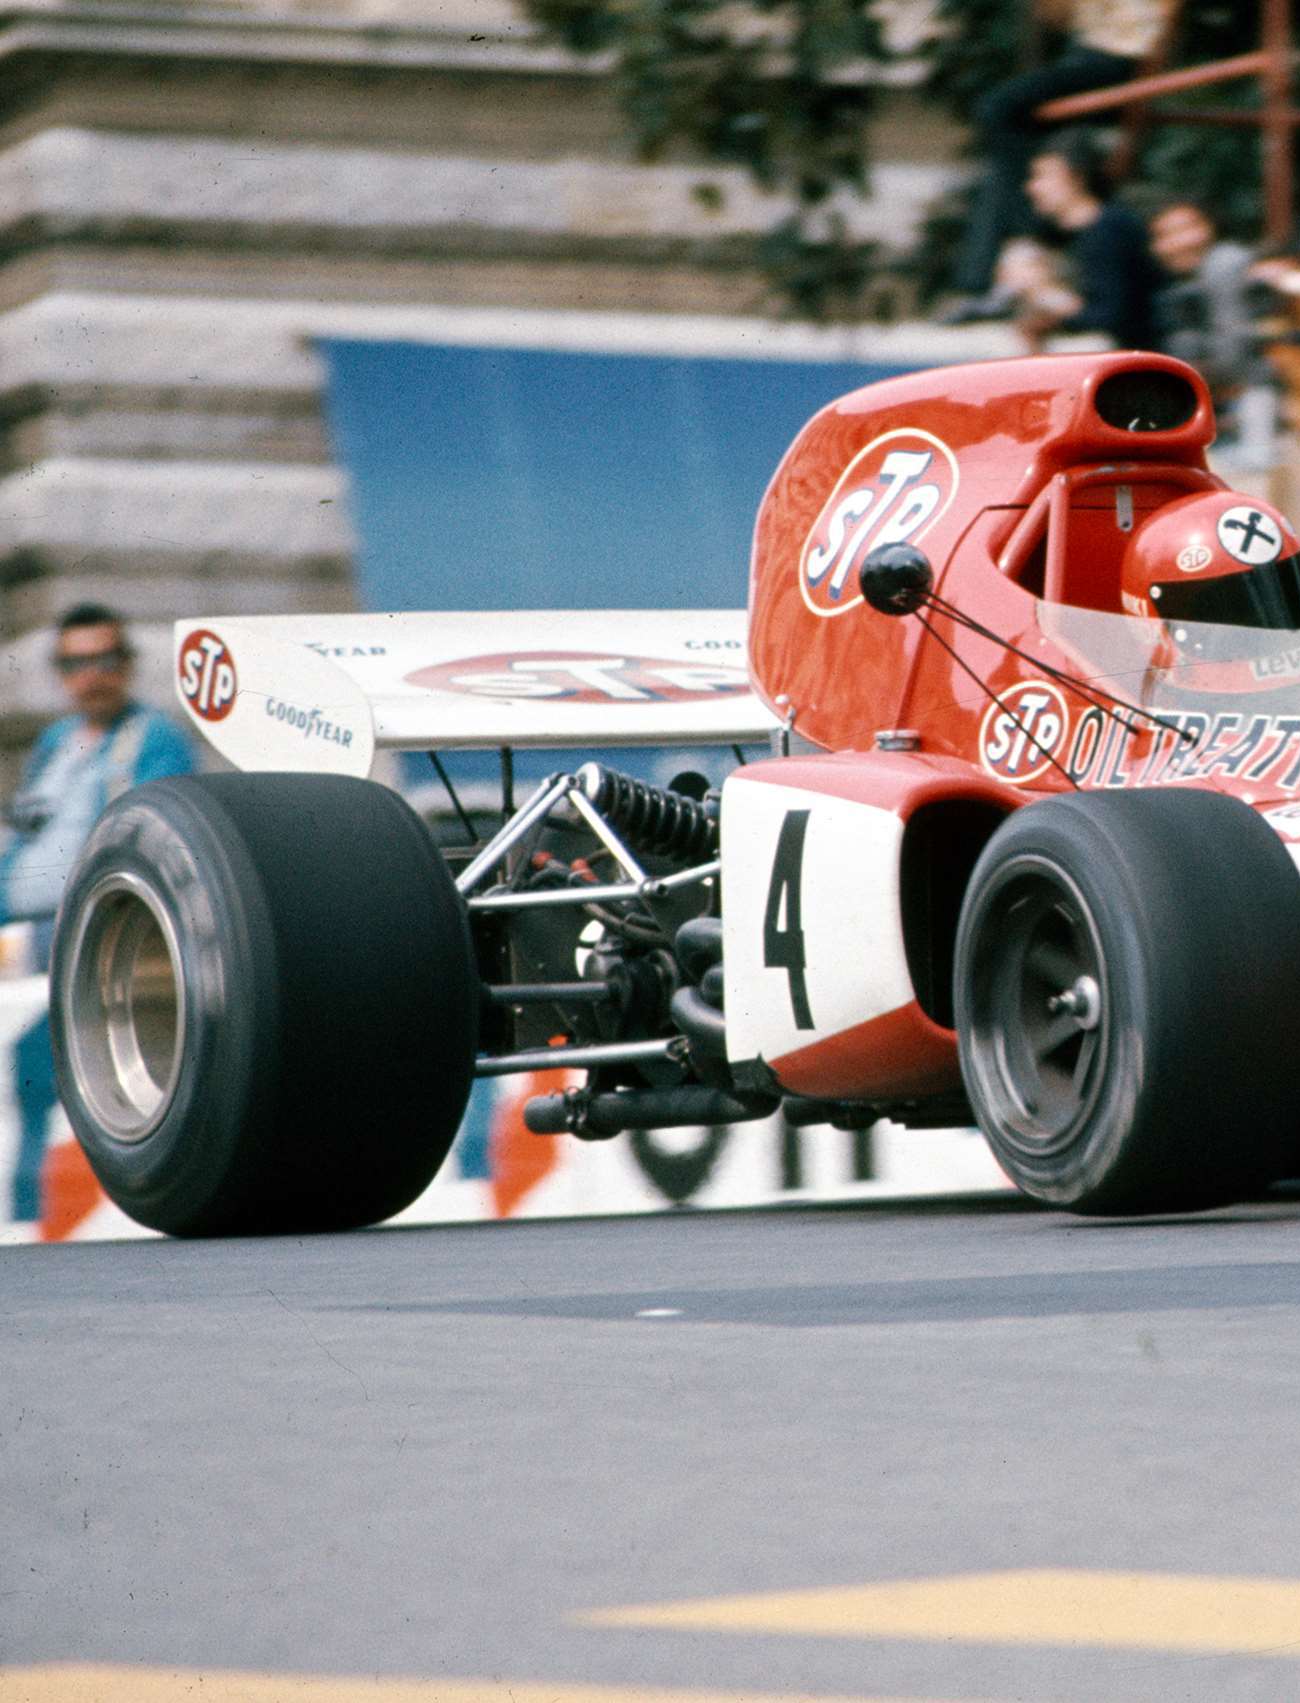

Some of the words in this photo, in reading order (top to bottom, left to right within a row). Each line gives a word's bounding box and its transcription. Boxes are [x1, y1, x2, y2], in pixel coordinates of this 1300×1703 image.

[805, 450, 941, 600] STP
[181, 637, 236, 714] STP
[449, 658, 752, 701] STP
[265, 696, 354, 749] GOODYEAR
[985, 693, 1057, 774] STP
[1067, 708, 1135, 790] OIL
[763, 808, 816, 1032] 4
